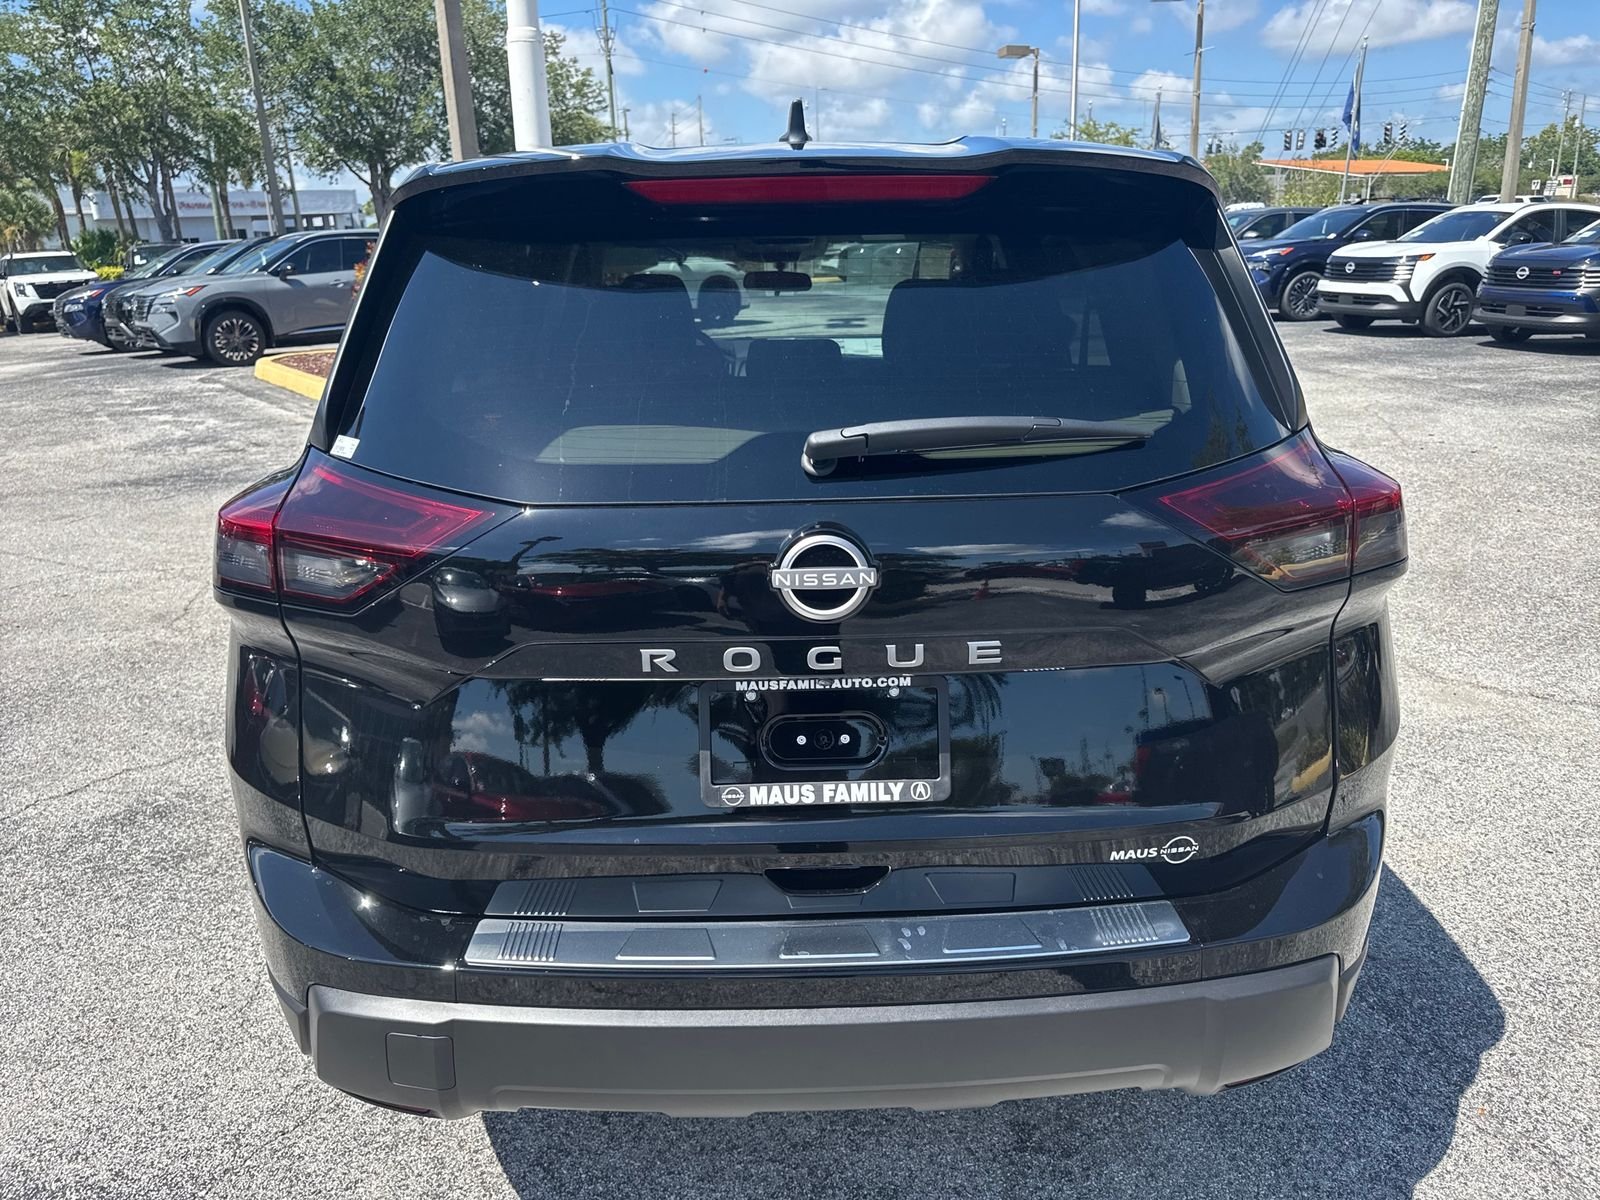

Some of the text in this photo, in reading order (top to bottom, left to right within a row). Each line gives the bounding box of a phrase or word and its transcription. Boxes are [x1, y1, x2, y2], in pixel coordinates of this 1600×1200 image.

[775, 571, 875, 587] NISSAN
[640, 641, 1002, 672] ROGUE
[750, 784, 817, 806] MAUS
[823, 782, 904, 803] FAMILY
[1110, 845, 1199, 861] MAUS NISSAN
